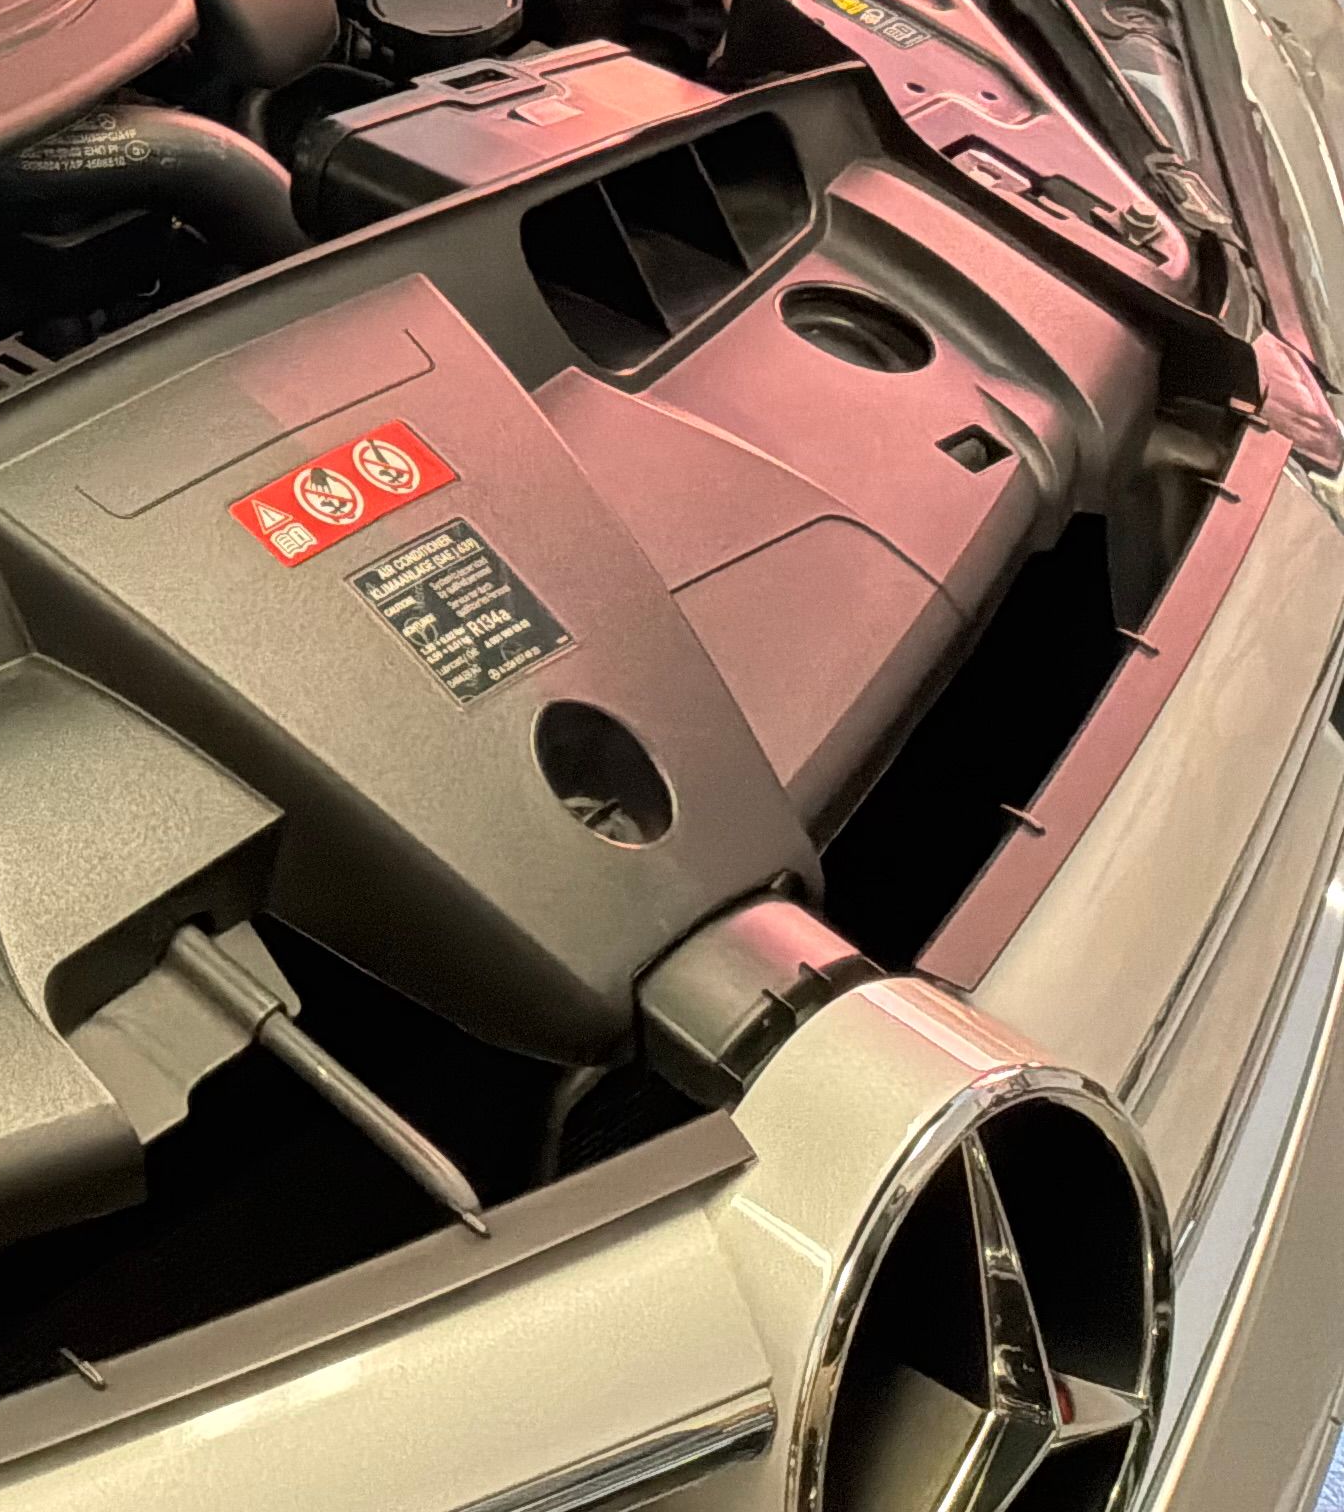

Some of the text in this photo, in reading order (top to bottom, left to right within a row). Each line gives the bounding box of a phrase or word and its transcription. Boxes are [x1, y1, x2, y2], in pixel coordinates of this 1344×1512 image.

[377, 533, 453, 581] AIR CONDITIONER
[369, 558, 436, 601] KLIMAANLAGE
[467, 608, 512, 638] R134a
